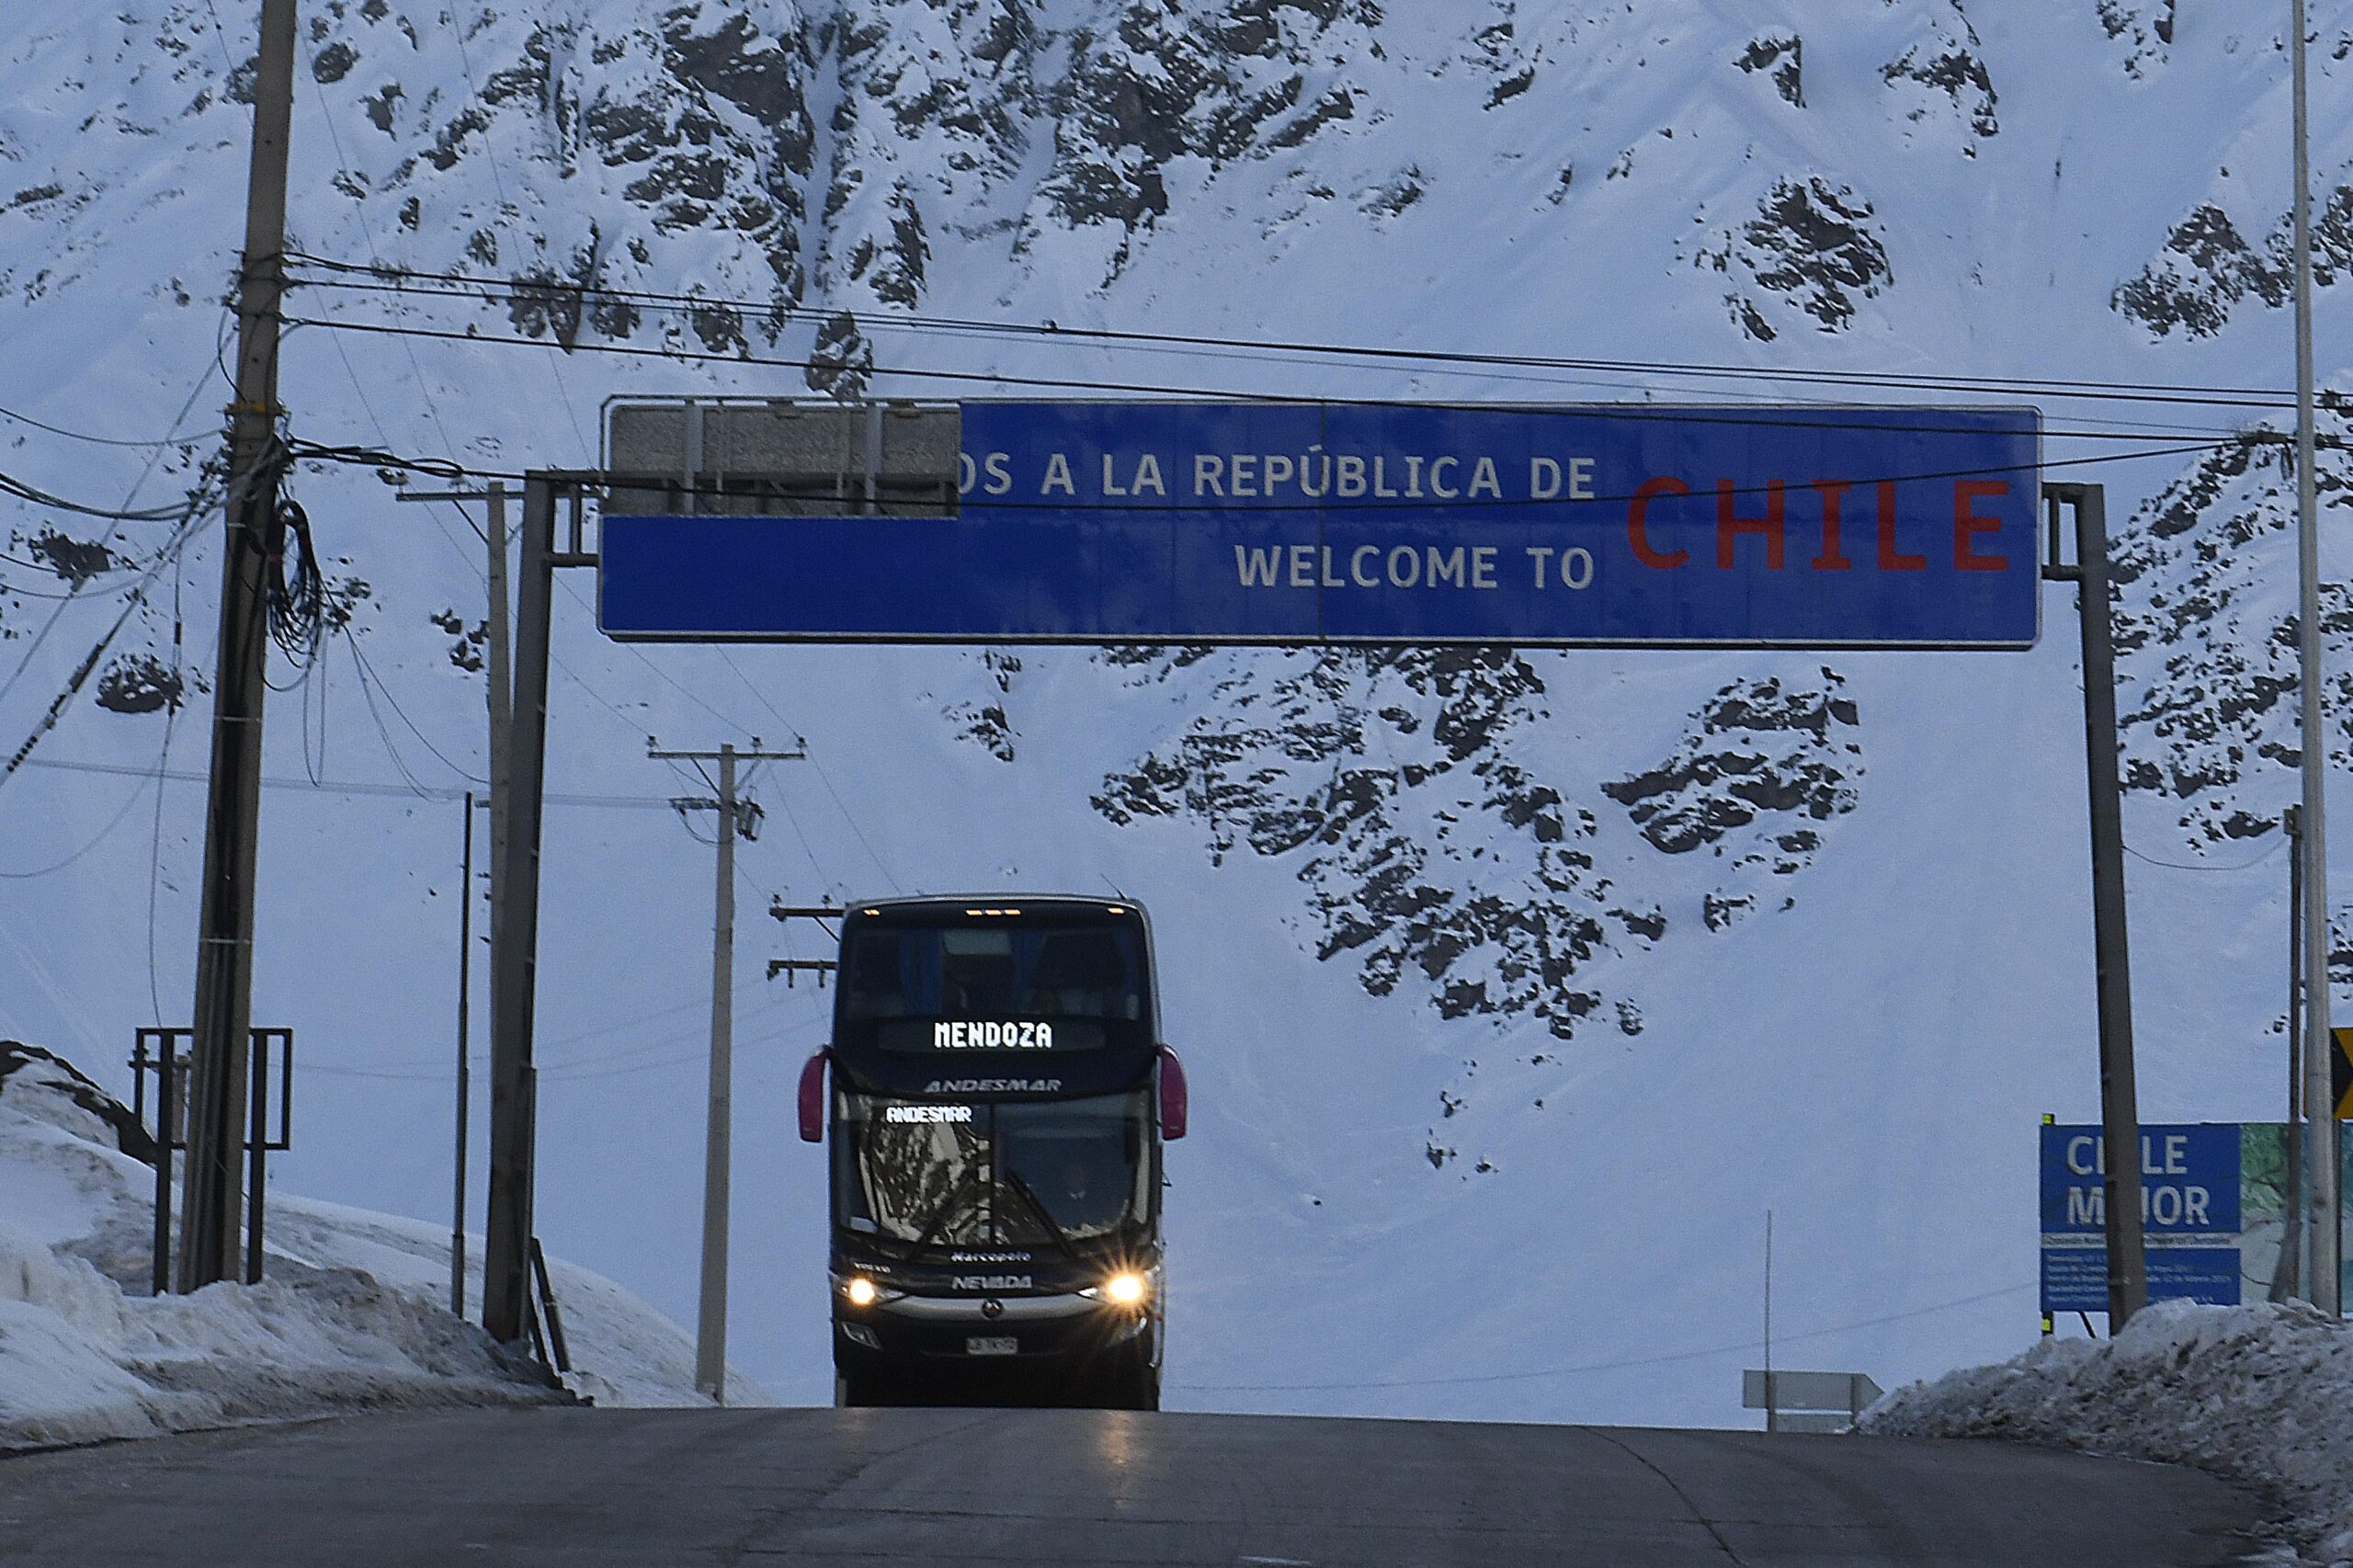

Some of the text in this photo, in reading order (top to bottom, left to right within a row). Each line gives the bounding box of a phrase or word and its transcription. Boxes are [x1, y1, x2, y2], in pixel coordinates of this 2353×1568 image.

[1040, 453, 1076, 495] A
[1102, 453, 1166, 495] LA
[1193, 444, 1503, 499] REPÚBLICA
[1529, 457, 1597, 499] DE
[1626, 474, 2010, 573] CHILE
[1233, 544, 1595, 590] WELCOME TO
[934, 1021, 1052, 1049] MENDOZA
[924, 1079, 1063, 1093] ANDESMAR
[885, 1106, 972, 1123] ANDESMAR
[2066, 1135, 2188, 1176] CLE
[2067, 1186, 2211, 1226] MJOR
[951, 1275, 1033, 1290] NEVADA
